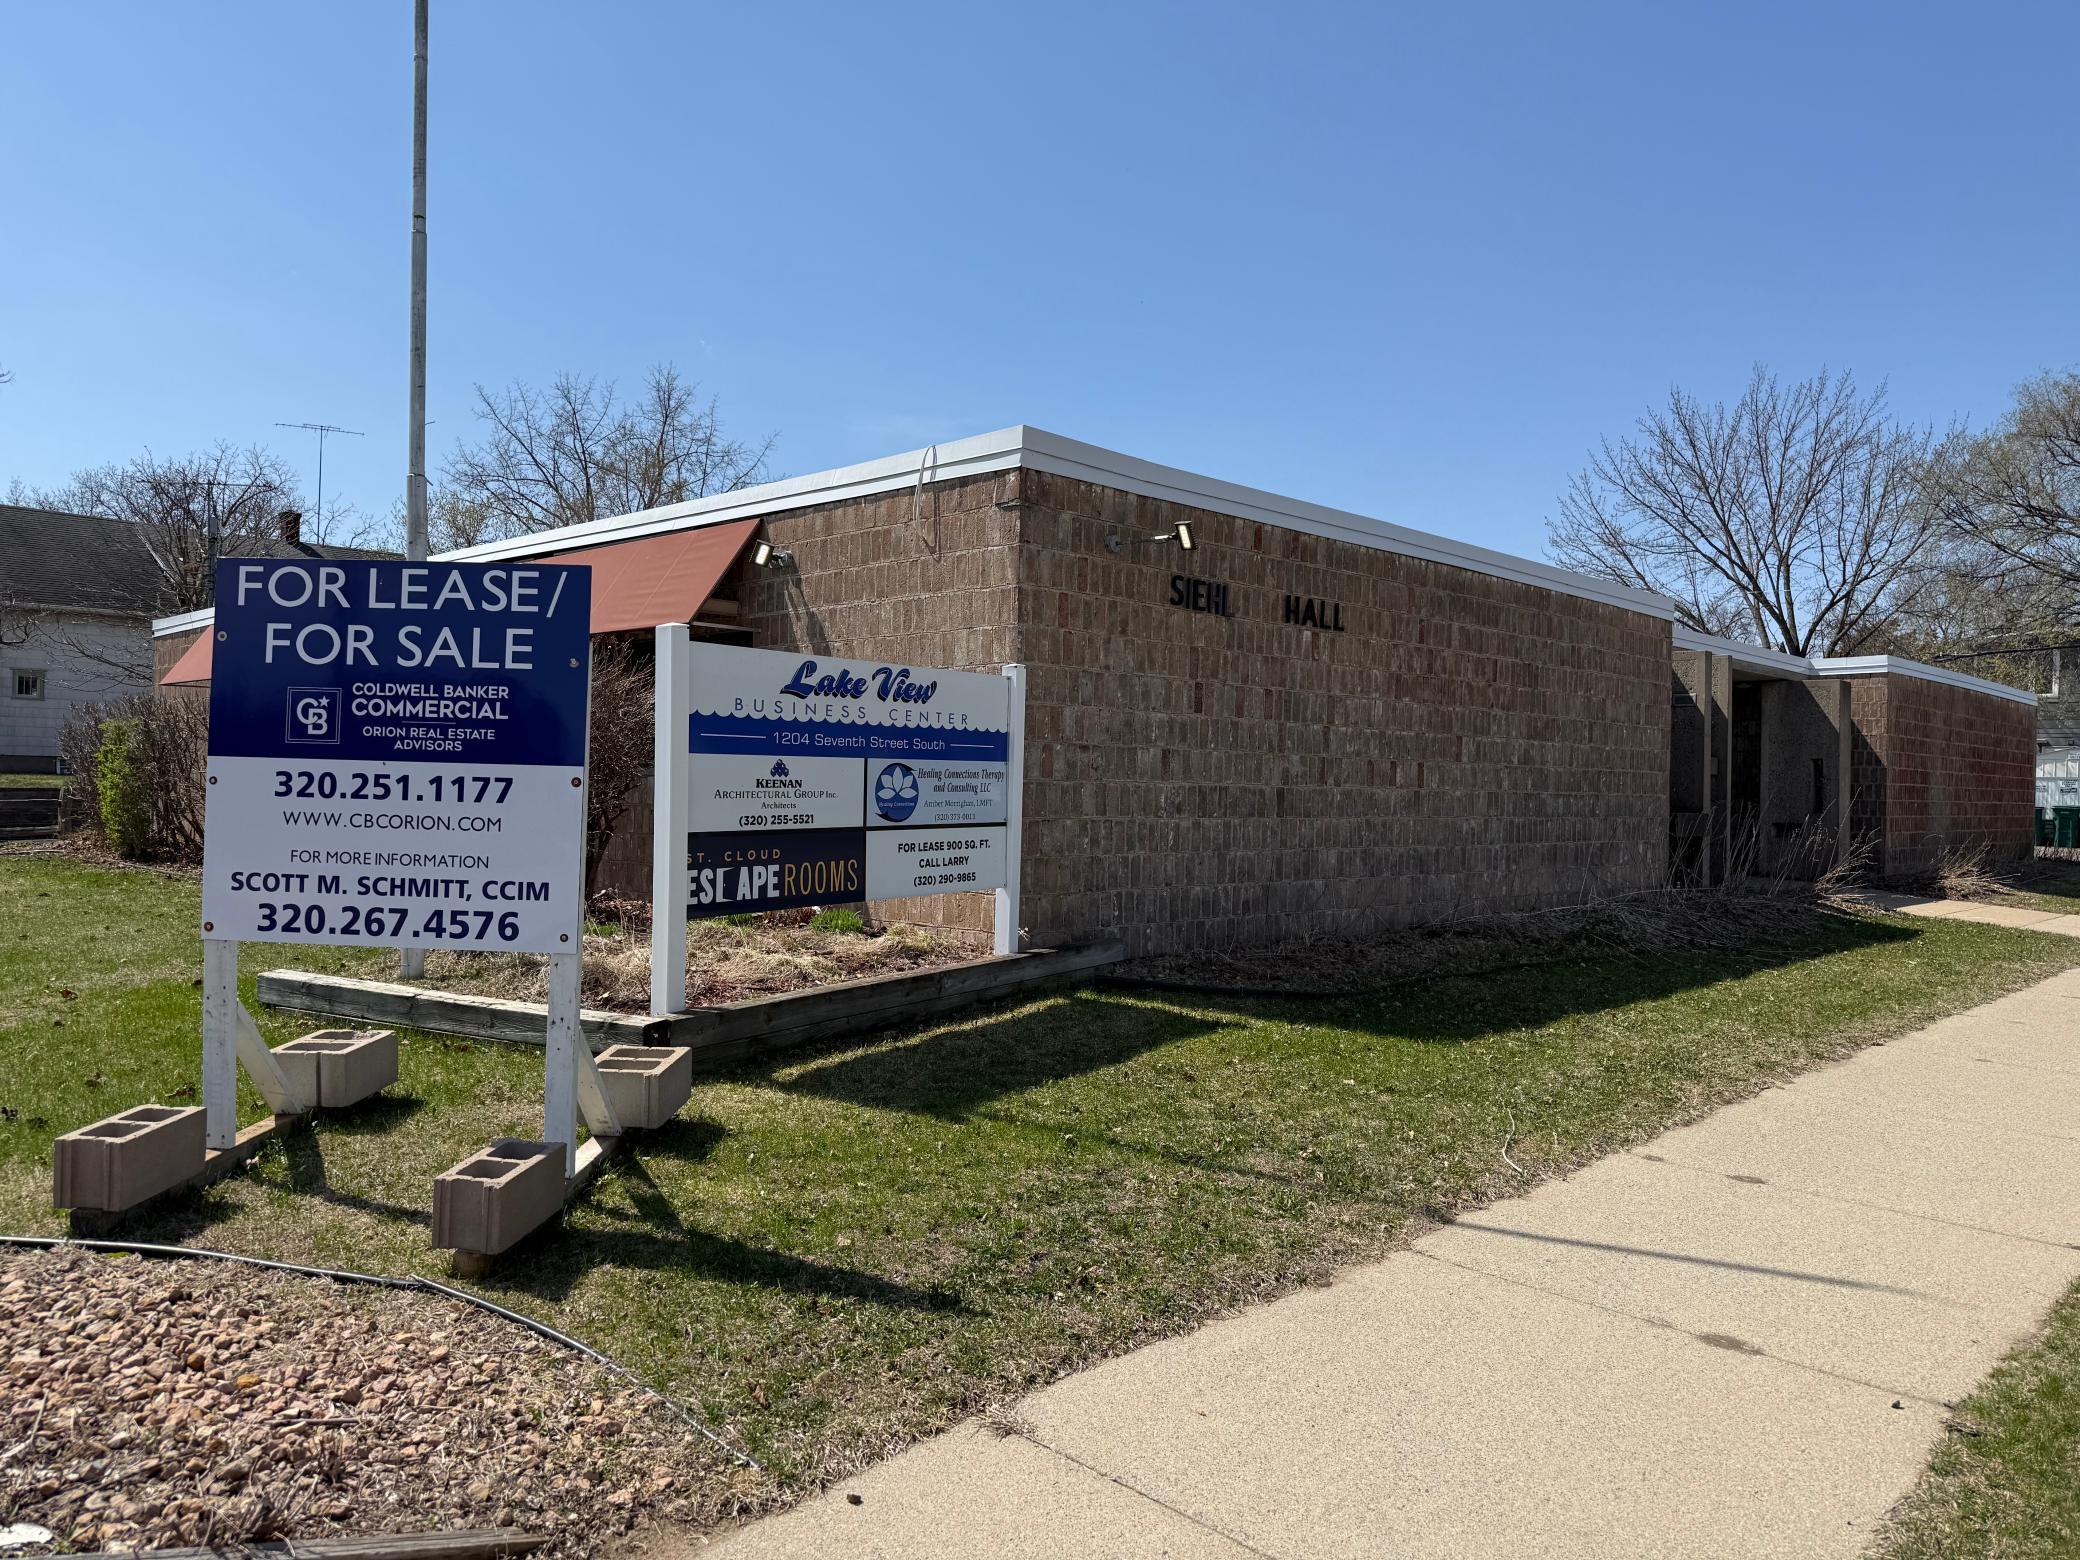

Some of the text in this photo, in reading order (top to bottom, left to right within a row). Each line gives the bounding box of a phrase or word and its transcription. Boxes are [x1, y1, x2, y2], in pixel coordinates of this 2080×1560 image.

[237, 565, 568, 618] FOR LEASE/
[1285, 594, 1345, 631] HALL
[265, 622, 534, 670] FOR SALE
[352, 682, 510, 699] COLDWELL BANKER
[779, 660, 938, 705] Lake View
[351, 698, 509, 720] COMMERCIAL
[734, 697, 968, 725] BUSINESS CENTER
[362, 726, 496, 740] ORION REAL ESTATE
[773, 732, 946, 750] 1204 Seventh Street South
[394, 740, 463, 752] ADVISORS
[755, 778, 803, 789] KEENAN
[918, 768, 1004, 783] Healing Connections Therapy
[274, 771, 514, 804] 320.251.1177
[714, 788, 839, 799] ARCHITECTURAL GROUP Inc.
[933, 782, 991, 795] and Consulting LLC
[761, 801, 797, 809] Architects
[283, 811, 502, 833] WWW.CBCORION.COM
[738, 814, 814, 827] (320) 255-5521
[898, 839, 990, 853] FOR LEASE 900 SQ. FT.
[290, 850, 489, 869] FOR MORE INFORMATION
[687, 849, 781, 864] ST. CLOUD
[919, 856, 969, 868] CALL LARRY
[785, 859, 858, 896] ROOMS
[913, 872, 976, 887] (320) 290-9865
[230, 871, 550, 902] SCOTT M. SCHMITT, CCIM
[257, 903, 520, 942] 320.267.4576
